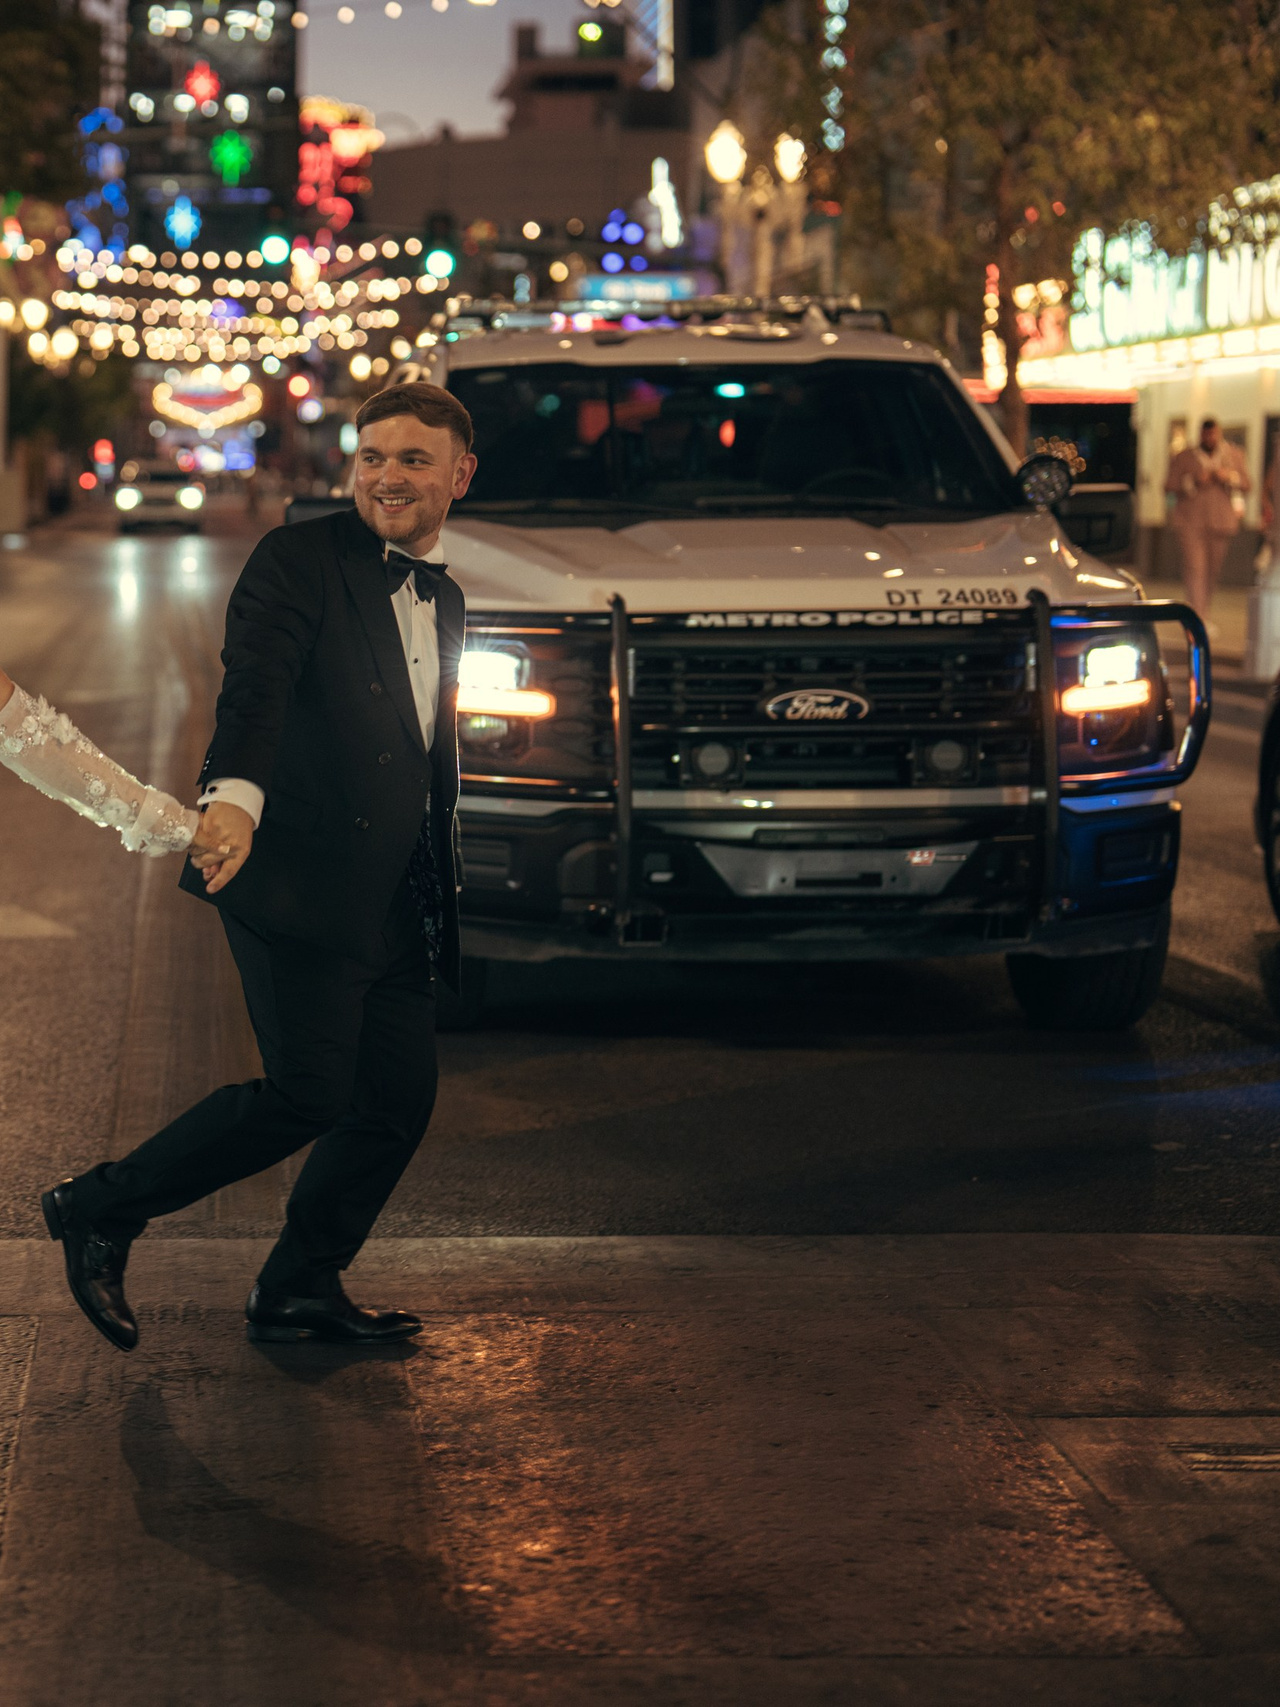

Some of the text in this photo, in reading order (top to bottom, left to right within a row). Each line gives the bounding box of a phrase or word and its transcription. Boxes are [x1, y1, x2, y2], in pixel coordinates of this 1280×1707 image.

[886, 588, 1018, 606] DT 24089
[686, 610, 984, 628] METRO POLICE
[785, 694, 850, 720] Ford
